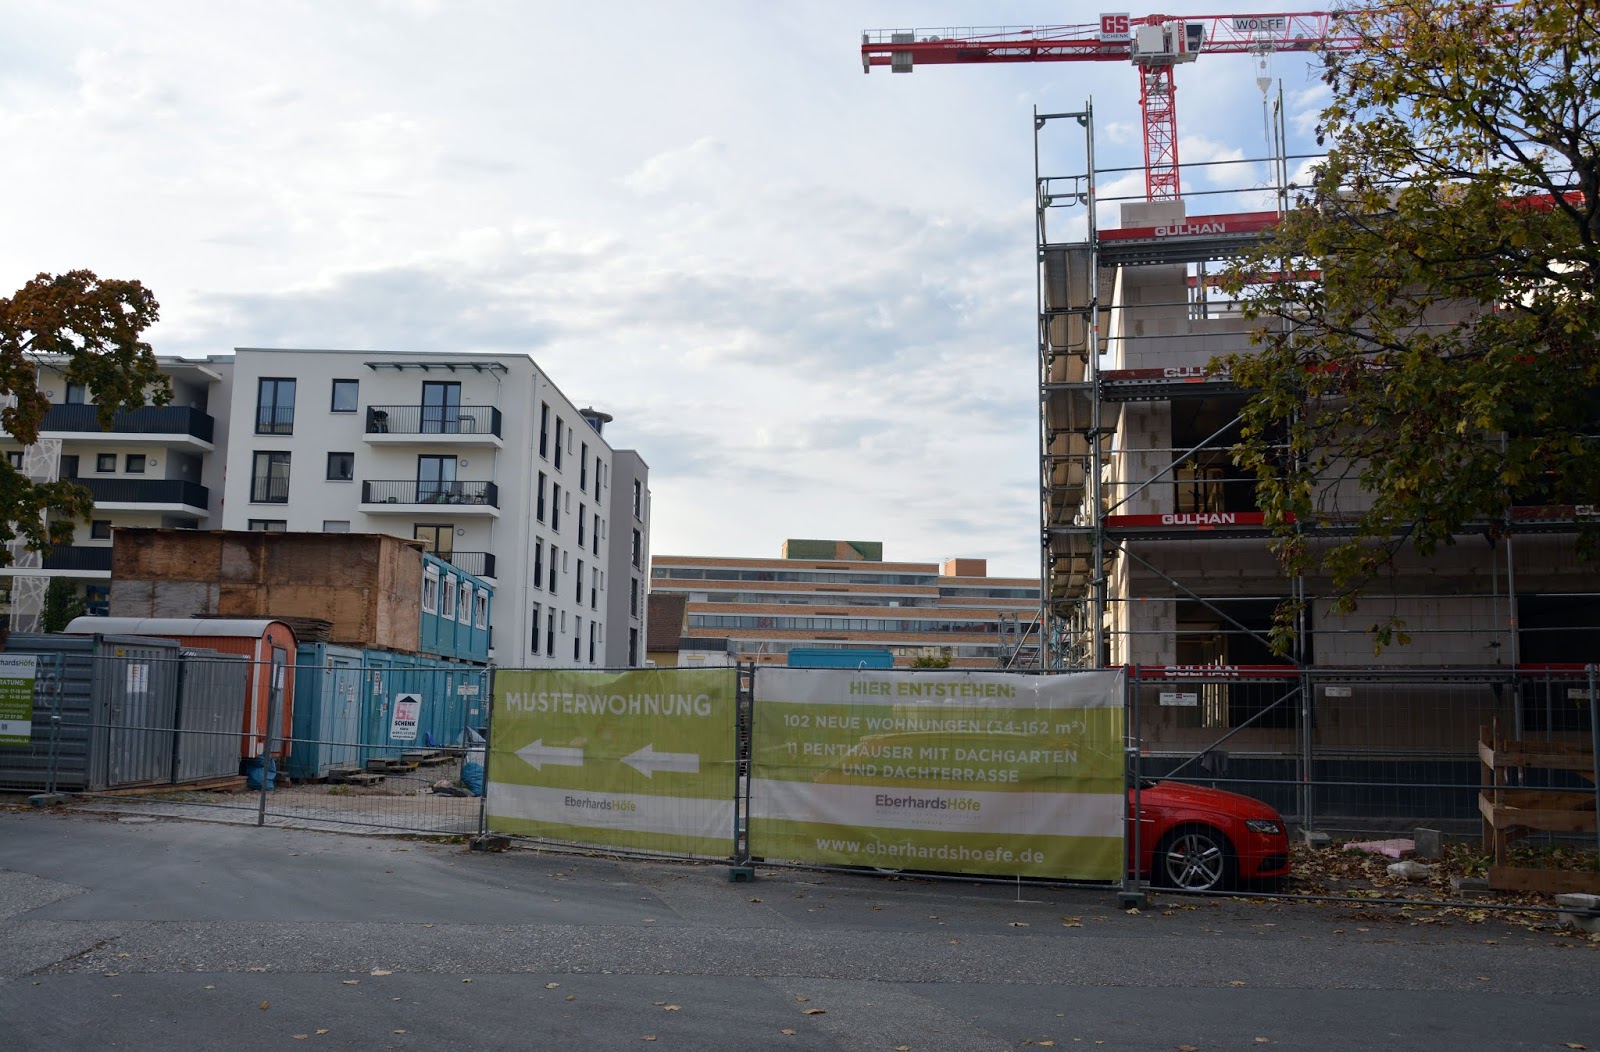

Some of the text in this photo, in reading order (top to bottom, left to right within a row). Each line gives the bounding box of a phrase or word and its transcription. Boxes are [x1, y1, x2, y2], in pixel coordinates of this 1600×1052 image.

[1101, 15, 1129, 33] GS
[1235, 18, 1284, 30] WOLFF
[1154, 222, 1226, 237] GULHAN
[1163, 366, 1231, 378] GULH
[1161, 512, 1236, 525] GULHAN
[0, 659, 35, 667] hardsHöfe
[1164, 665, 1239, 677] GULHAN
[850, 681, 1017, 698] HIER ENTSTEHEN:
[505, 691, 712, 717] MUSTERWOHNUNG
[784, 714, 810, 728] 102
[815, 715, 860, 729] NEUE
[866, 717, 980, 733] WOHNUNGEN
[987, 720, 1049, 735] (34-162
[787, 741, 1078, 764] 11 PENTHÄUSER MIT DACHGARTEN
[842, 763, 1020, 783] UND DACHTERRASSE
[564, 796, 637, 812] EberhardsHöfe
[875, 794, 982, 811] EberhardsHöfe
[816, 838, 1045, 864] www.eberhardshoefe.de
